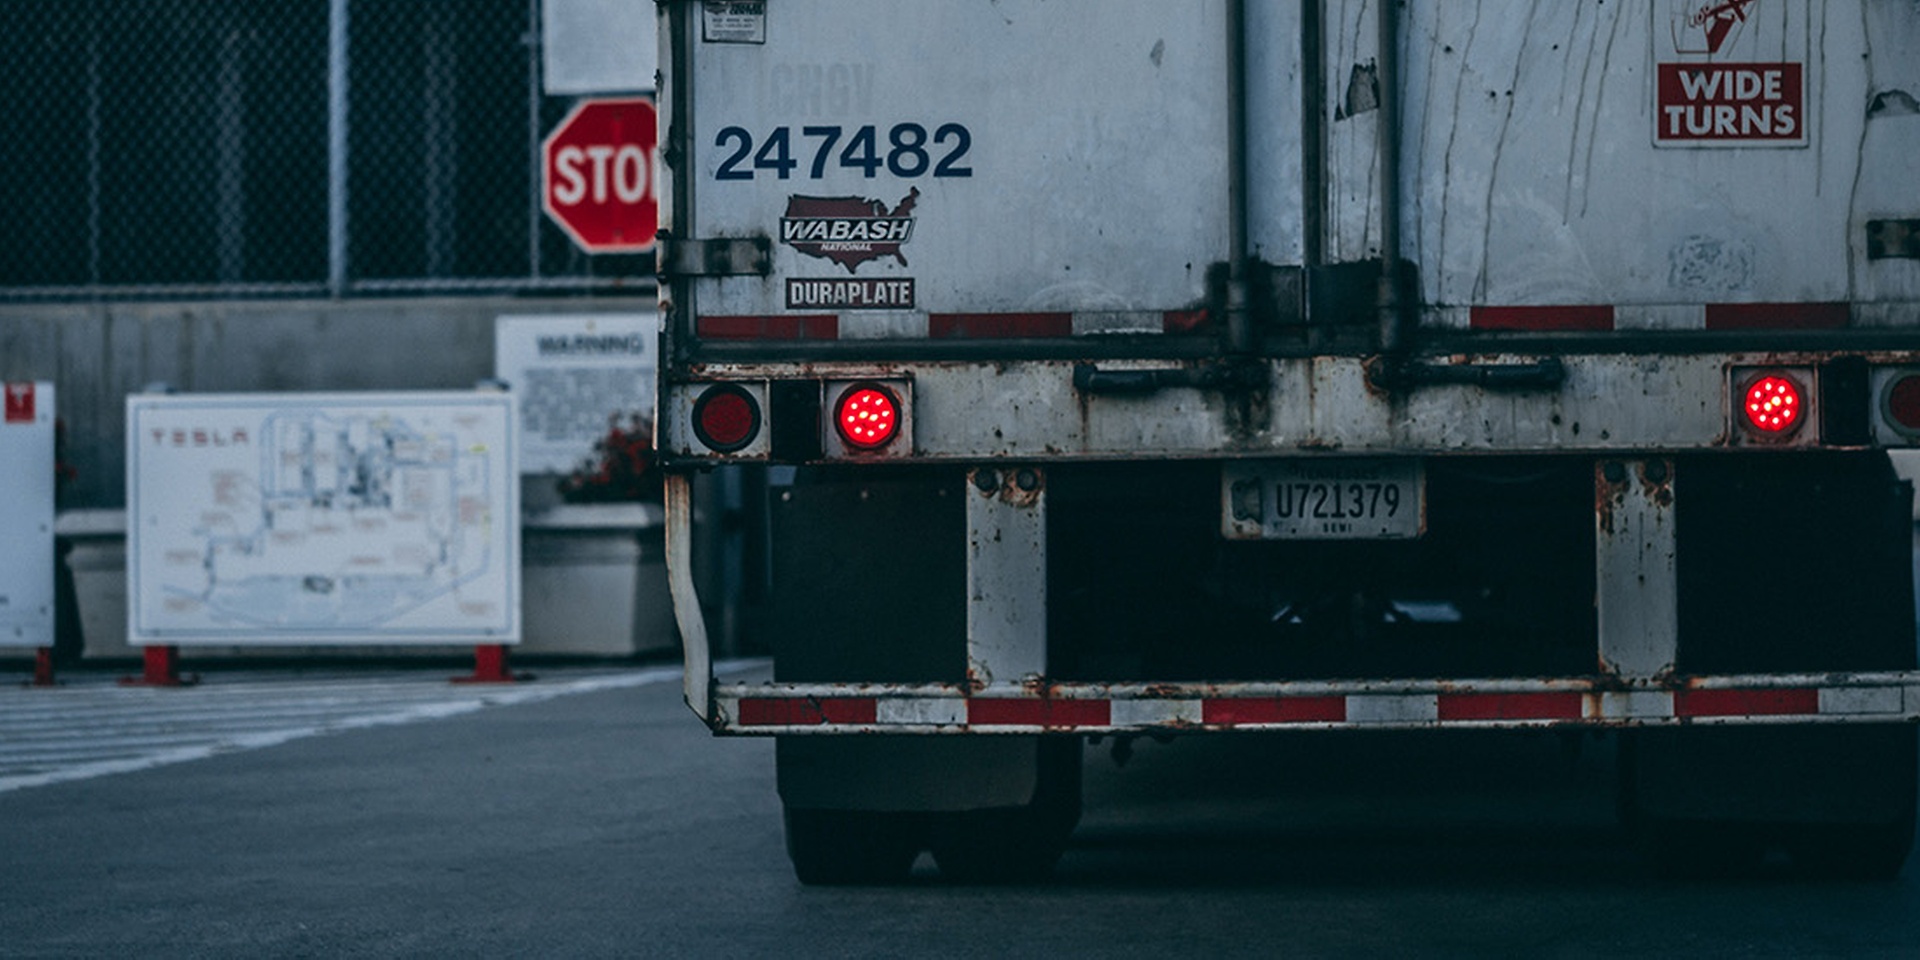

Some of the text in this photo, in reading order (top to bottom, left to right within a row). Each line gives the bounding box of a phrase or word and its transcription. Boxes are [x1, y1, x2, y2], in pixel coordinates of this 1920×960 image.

[1678, 70, 1782, 100] WIDE
[1664, 104, 1796, 135] TURNS
[715, 122, 973, 180] 247482
[783, 220, 911, 240] WABASH
[820, 243, 873, 251] NATIONAL
[790, 282, 911, 305] DURAPLATE
[537, 333, 644, 355] WARNING
[150, 427, 250, 447] TESLA
[1276, 482, 1400, 519] U721379
[1322, 522, 1353, 533] SEMI
